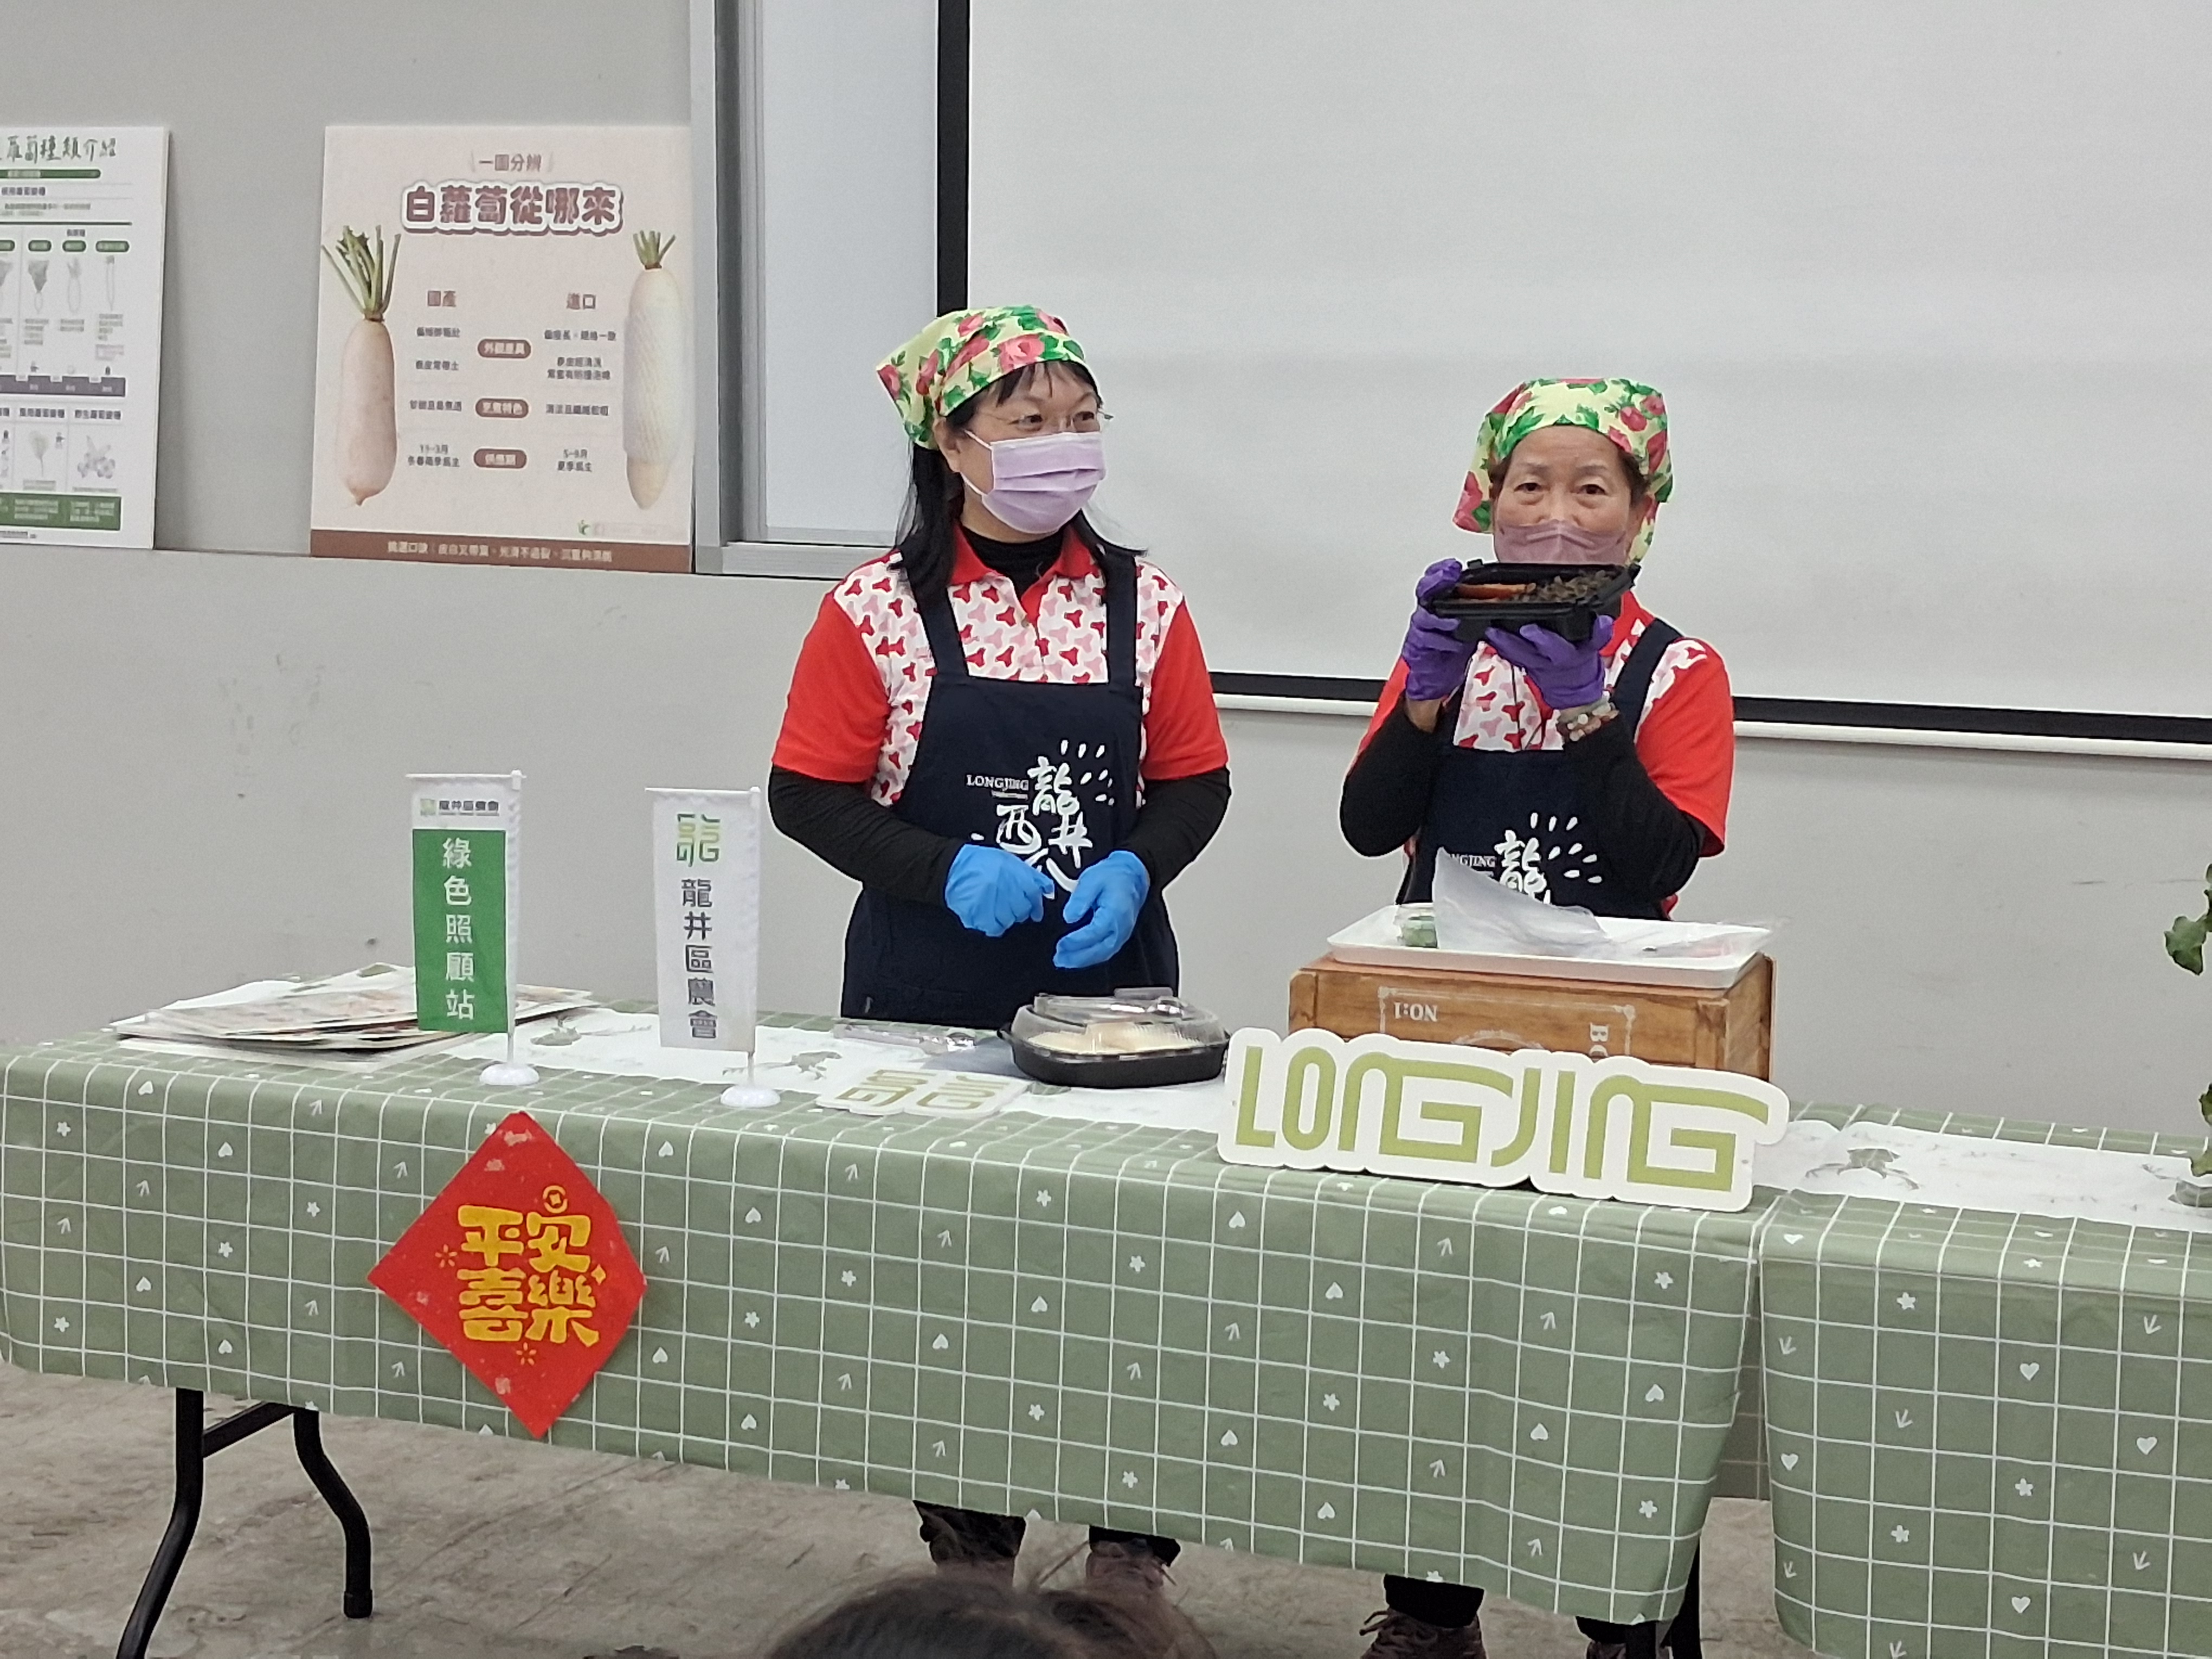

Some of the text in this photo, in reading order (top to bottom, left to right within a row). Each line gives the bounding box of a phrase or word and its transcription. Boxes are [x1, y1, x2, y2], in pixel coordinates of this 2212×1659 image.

[407, 185, 616, 225] 白蘿蔔從哪來
[442, 837, 474, 1020] 綠色照顧站
[681, 878, 718, 1039] 龍井區農會
[1236, 1045, 1769, 1193] LONGJING
[458, 1205, 591, 1272] 平安
[456, 1268, 600, 1347] 喜樂
